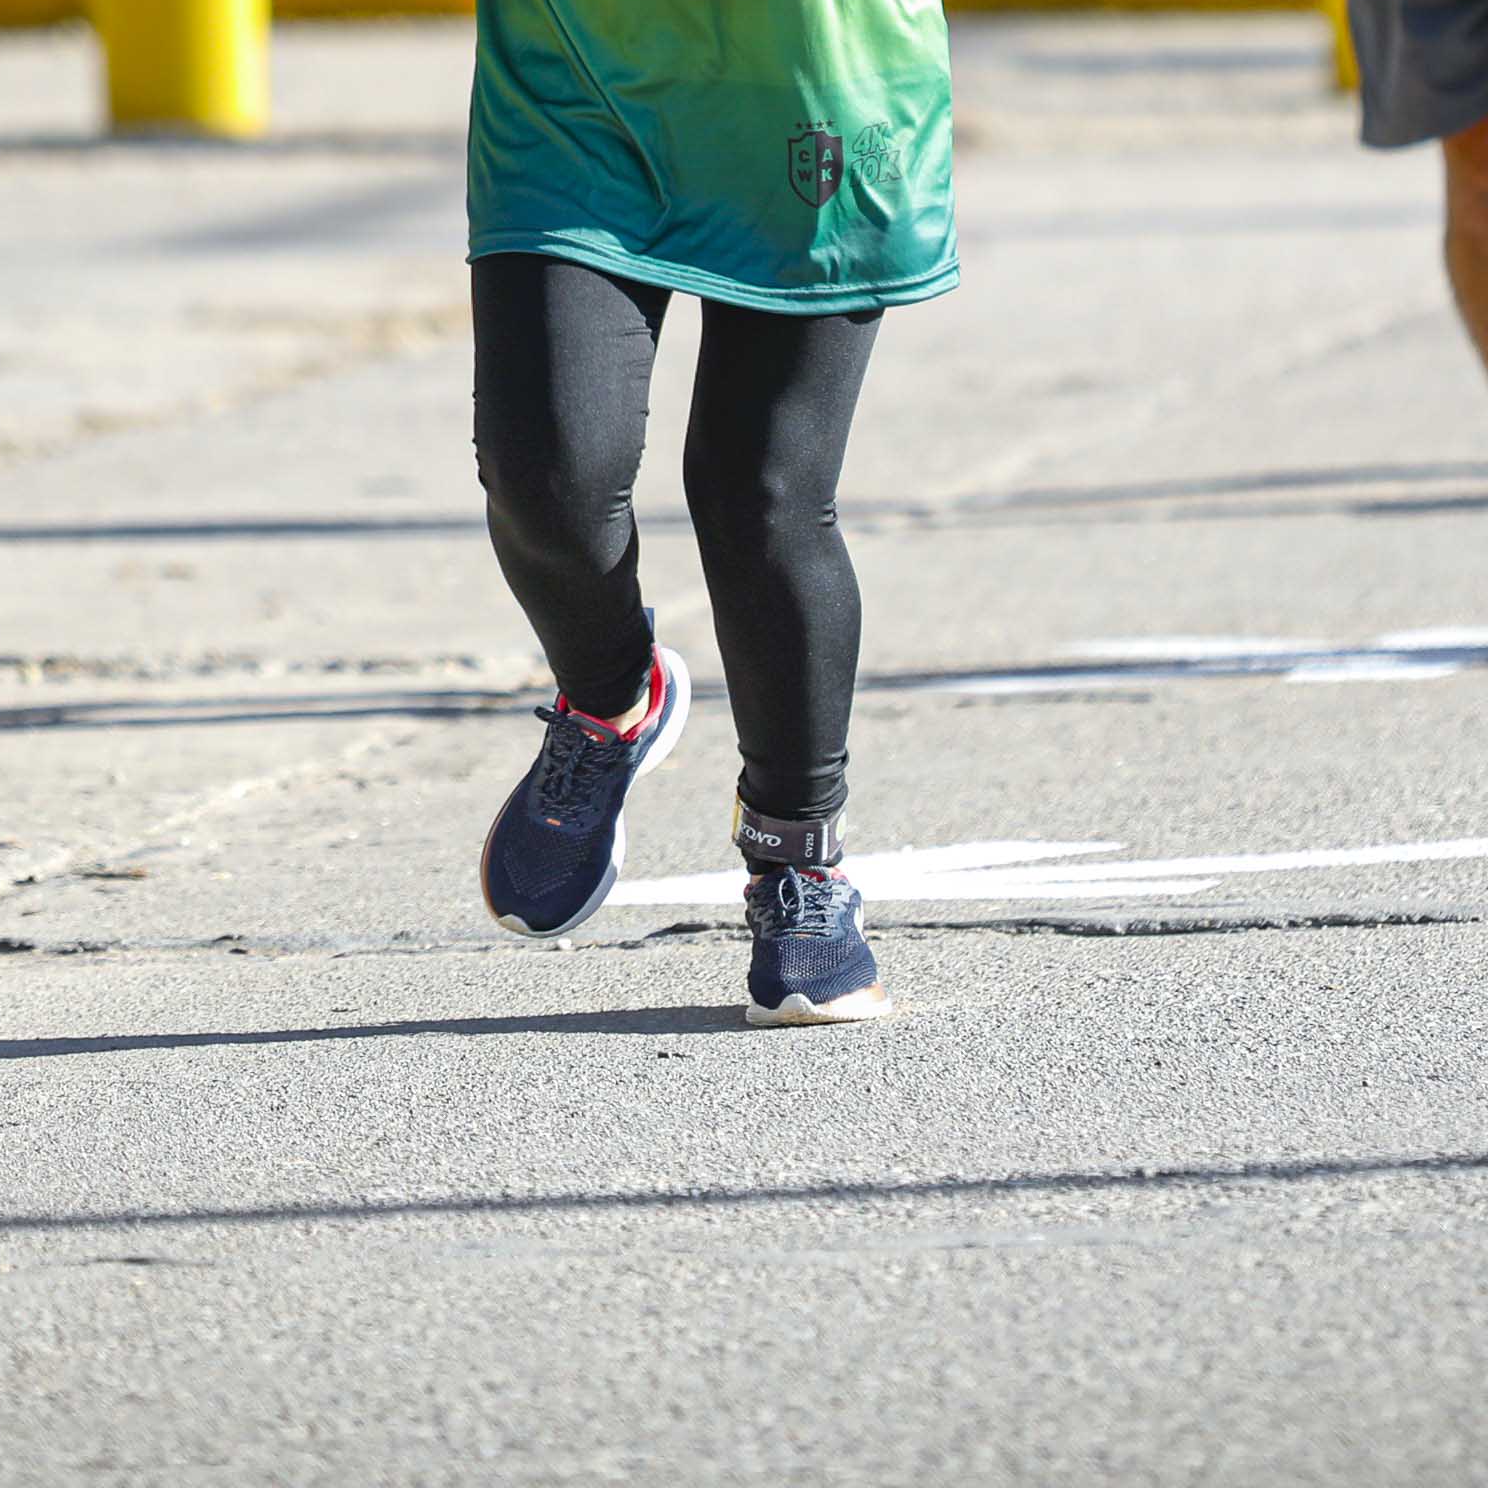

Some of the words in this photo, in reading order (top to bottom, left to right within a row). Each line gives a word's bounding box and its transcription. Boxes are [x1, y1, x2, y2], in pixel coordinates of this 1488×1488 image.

[853, 121, 889, 155] 4K
[798, 149, 811, 163] C
[822, 148, 834, 163] A
[797, 168, 814, 182] W
[821, 168, 833, 182] K
[850, 150, 903, 186] 10K
